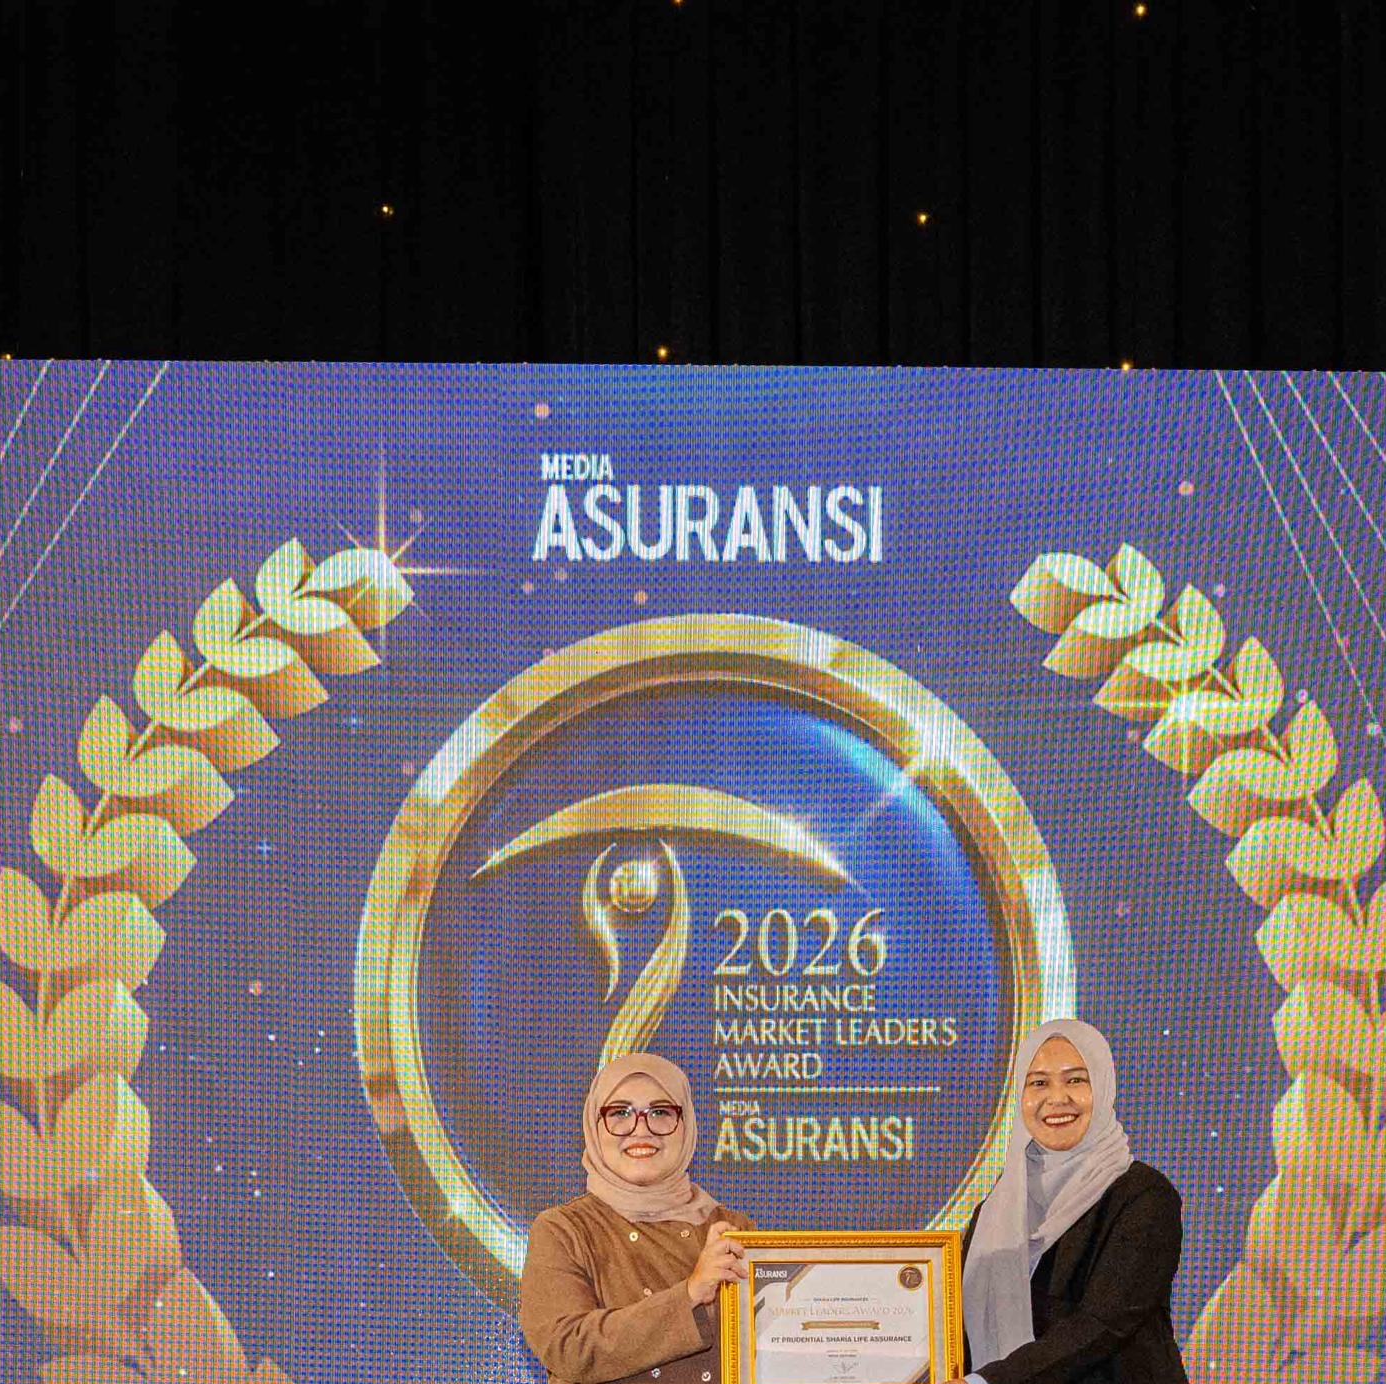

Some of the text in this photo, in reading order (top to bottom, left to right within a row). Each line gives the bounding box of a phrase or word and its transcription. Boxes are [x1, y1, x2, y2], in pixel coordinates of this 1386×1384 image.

[541, 454, 614, 480] MEDIA
[532, 484, 883, 563] ASURANSI
[714, 908, 887, 977] 2026
[714, 984, 876, 1012] INSURANCE
[714, 1017, 957, 1047] MARKET LEADERS
[714, 1053, 823, 1080] AWARD
[719, 1101, 760, 1116] MEDIA
[713, 1117, 915, 1161] ASURANSI
